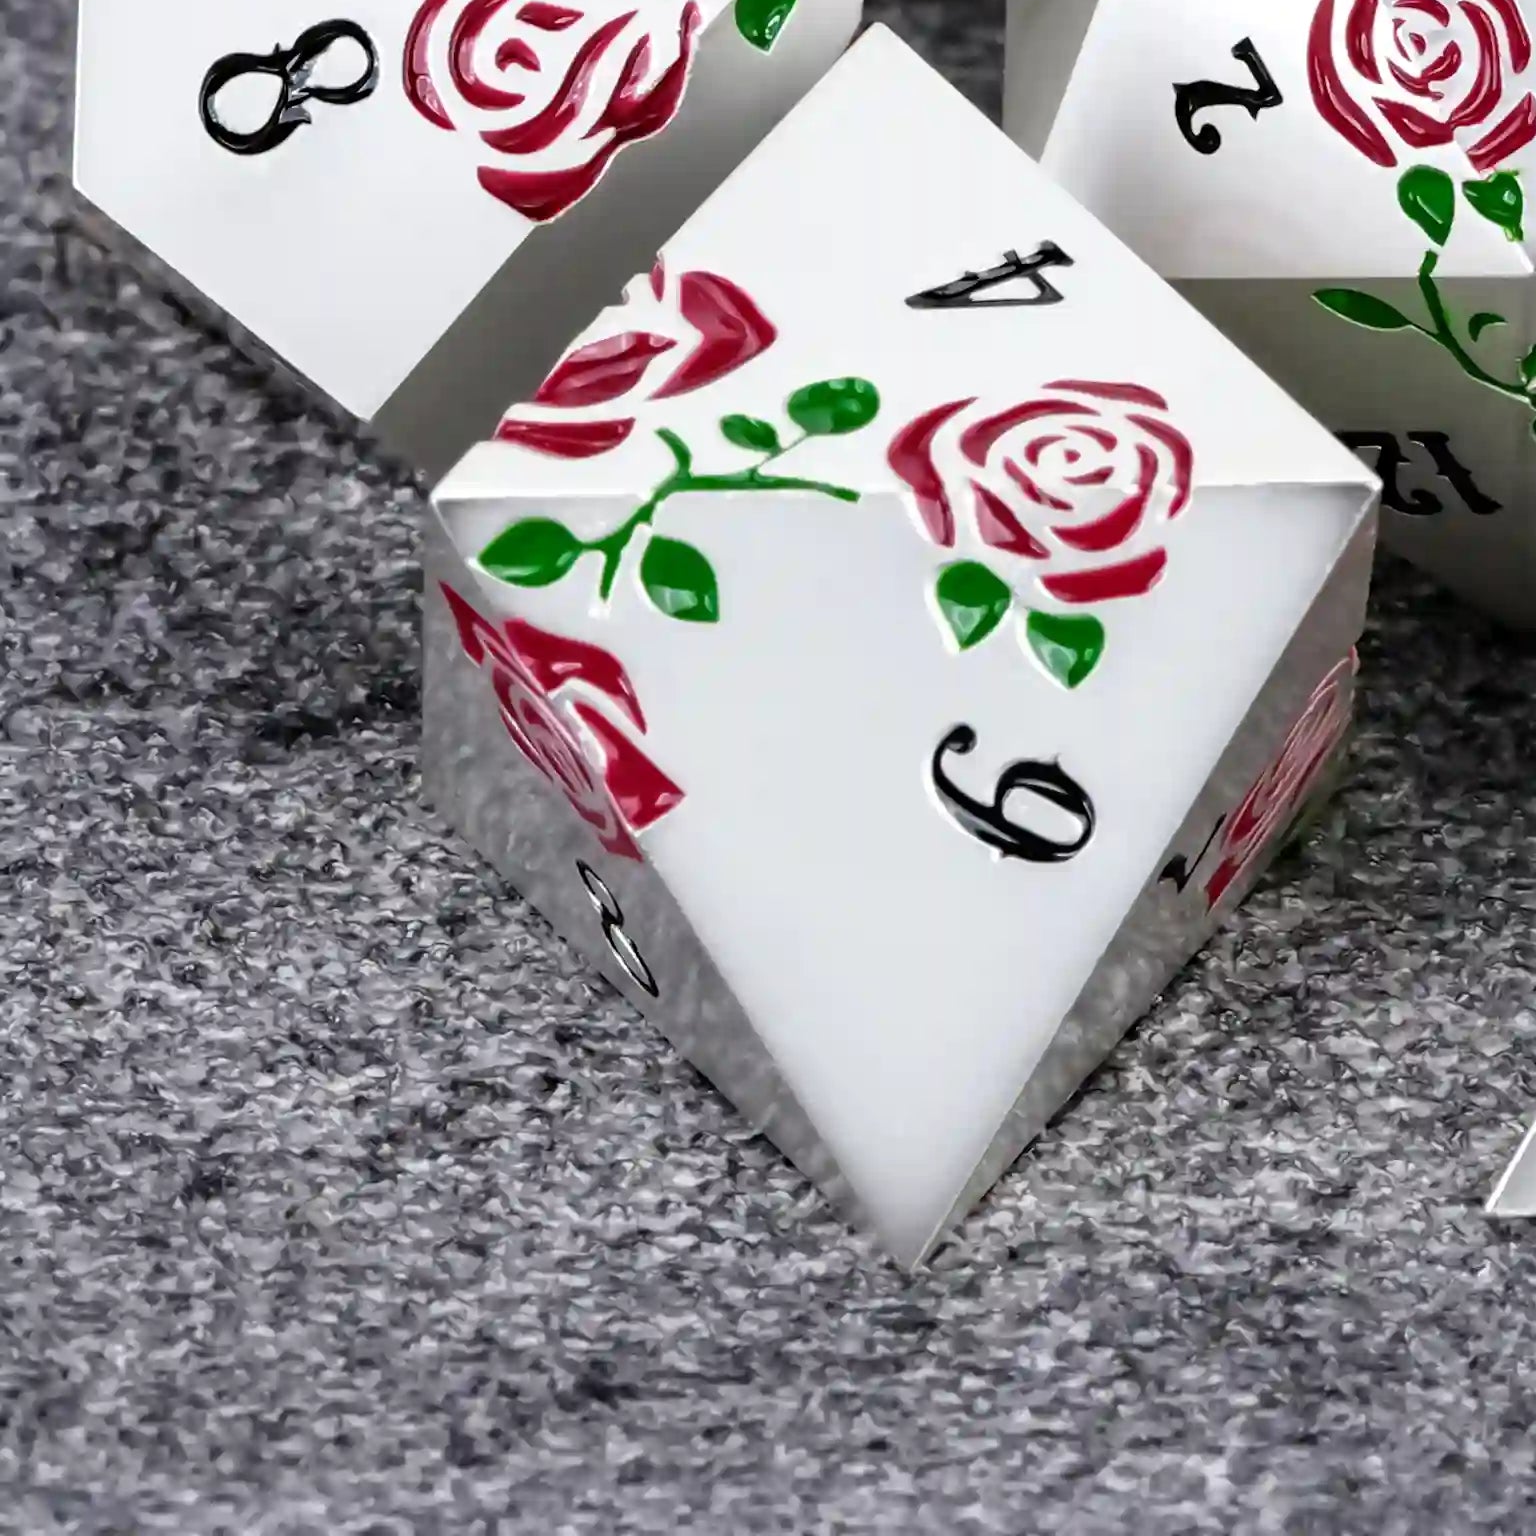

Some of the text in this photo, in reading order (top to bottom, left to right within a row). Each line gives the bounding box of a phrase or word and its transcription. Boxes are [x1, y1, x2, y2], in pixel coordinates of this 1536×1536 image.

[199, 19, 378, 155] 8
[1172, 37, 1283, 155] 2
[905, 241, 1074, 309] 4
